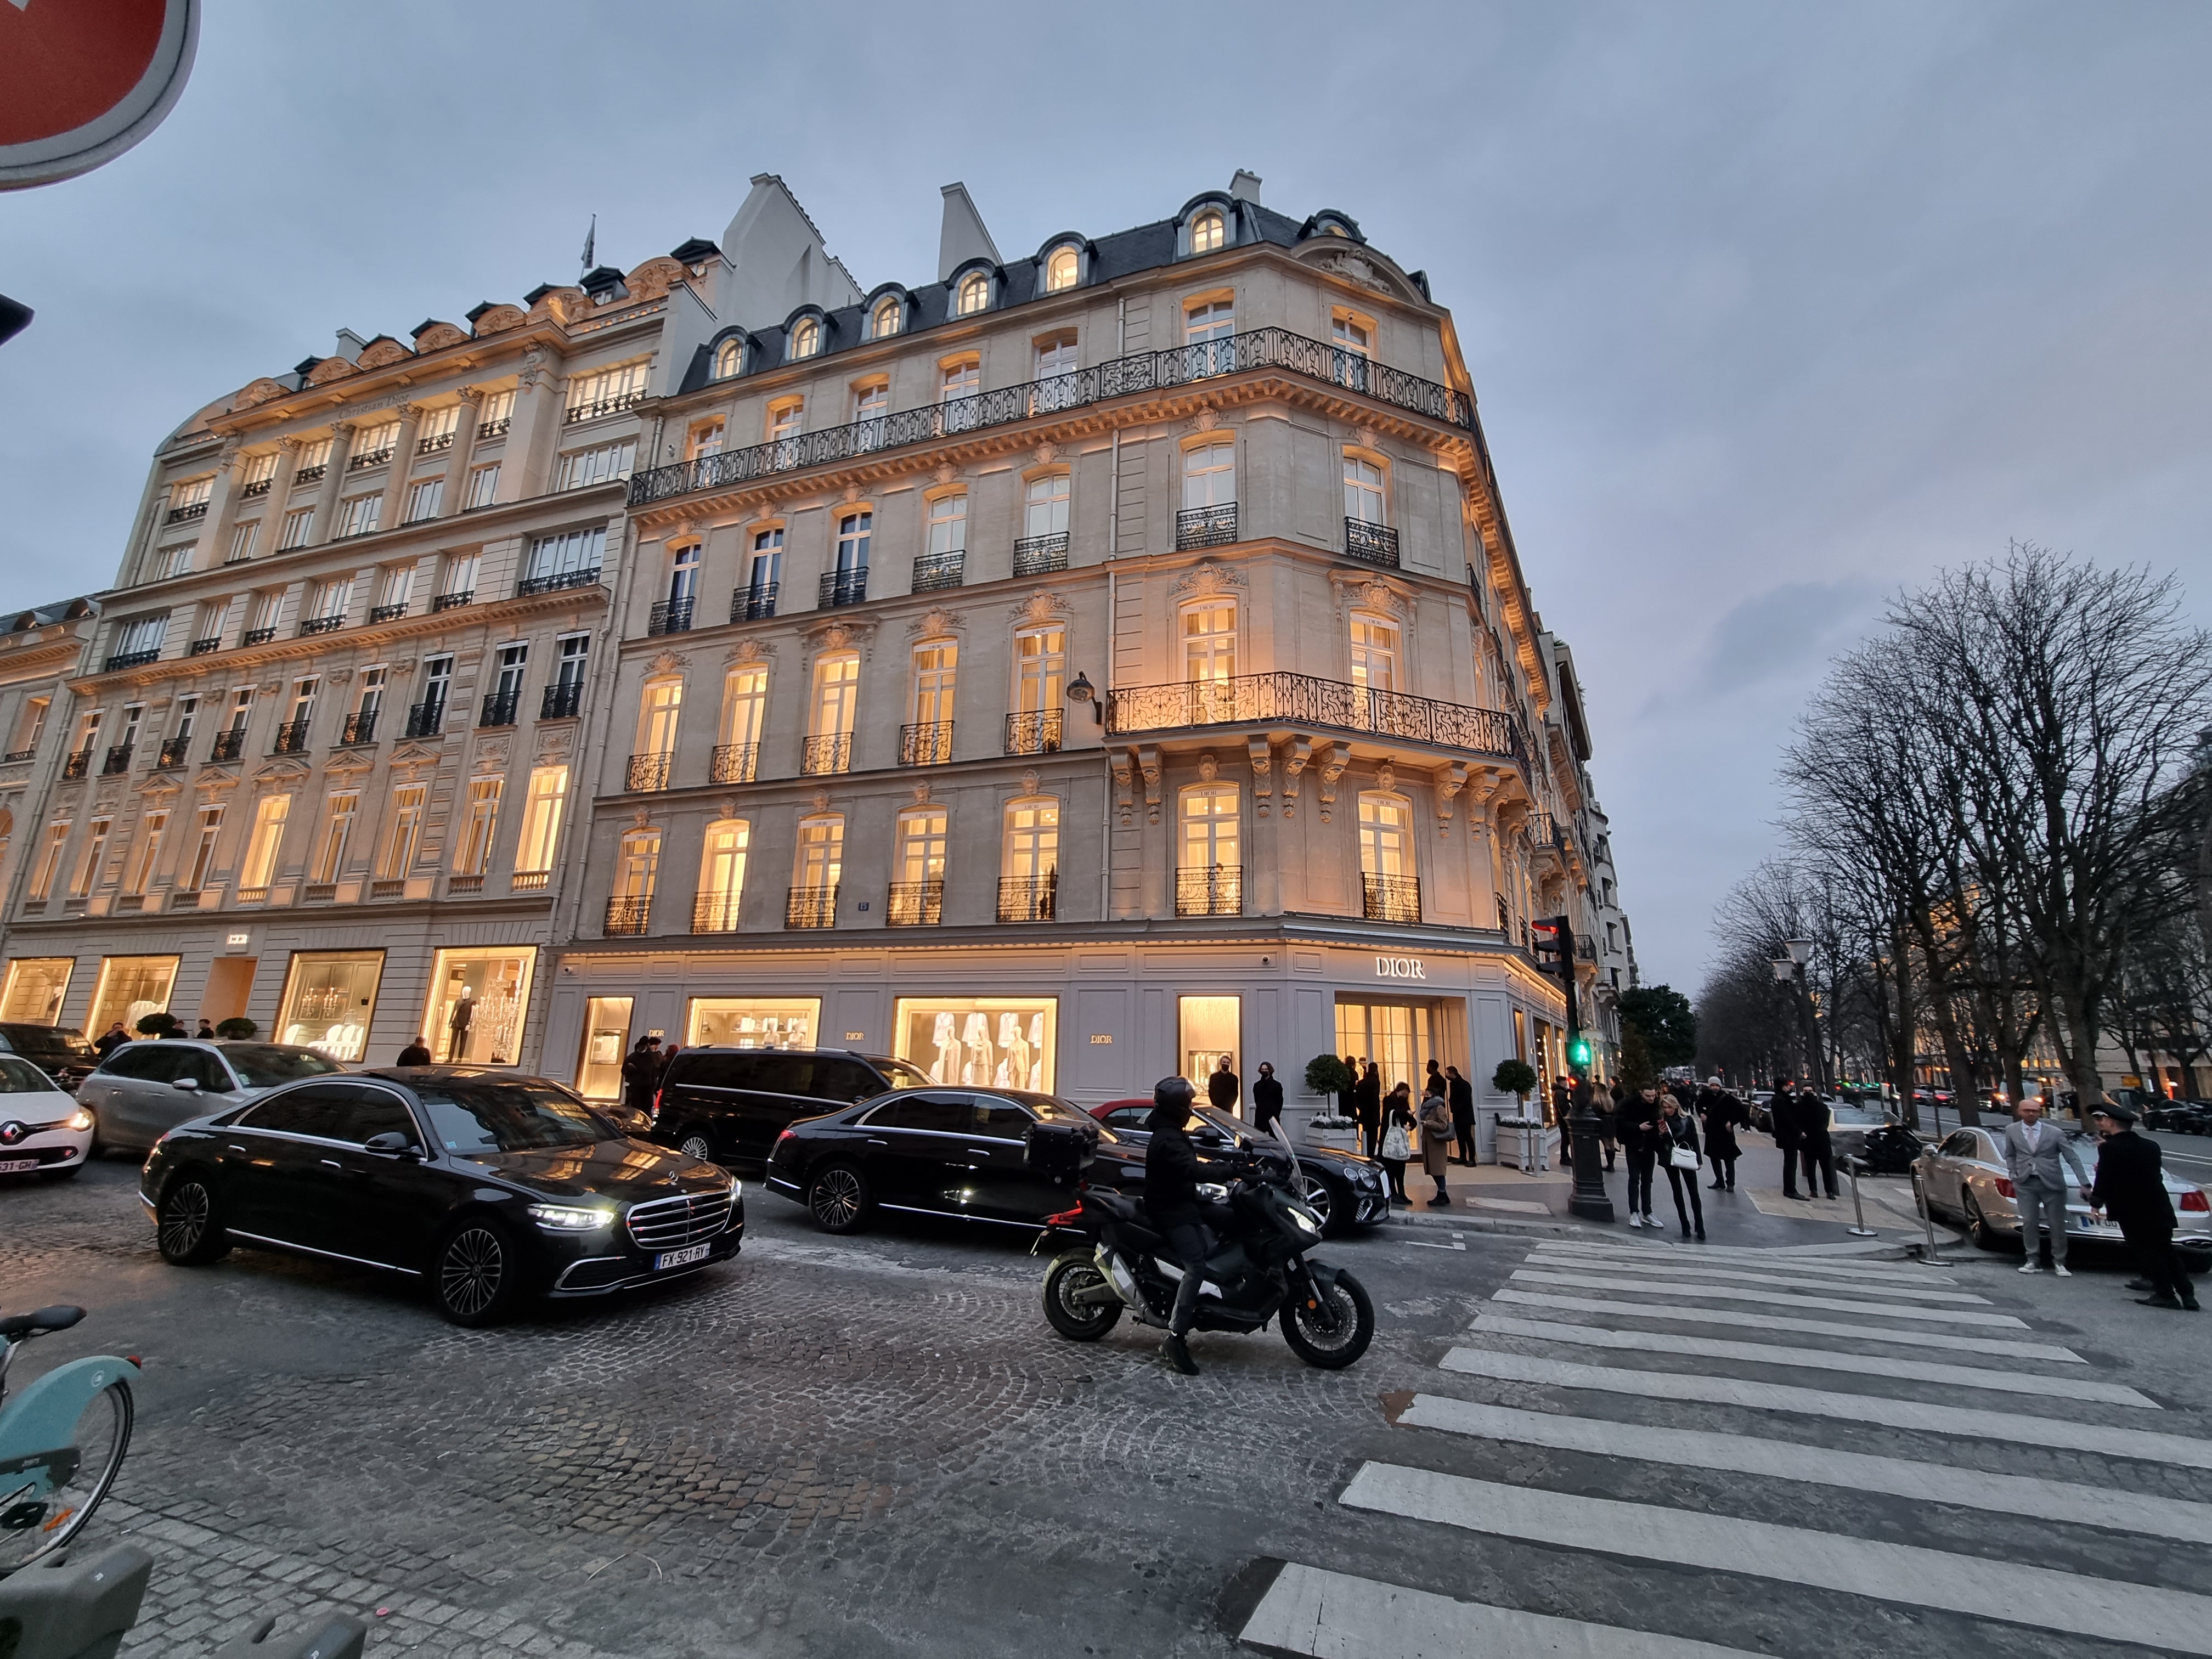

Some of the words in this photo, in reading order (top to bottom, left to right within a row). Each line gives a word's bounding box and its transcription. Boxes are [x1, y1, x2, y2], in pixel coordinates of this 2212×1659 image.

[387, 394, 409, 407] Dior
[1375, 957, 1426, 979] DIOR
[845, 1032, 864, 1040] DIOR
[1090, 1035, 1113, 1043] DIOR
[0, 1161, 32, 1171] 31-GH
[662, 1246, 705, 1267] FX-921-AY
